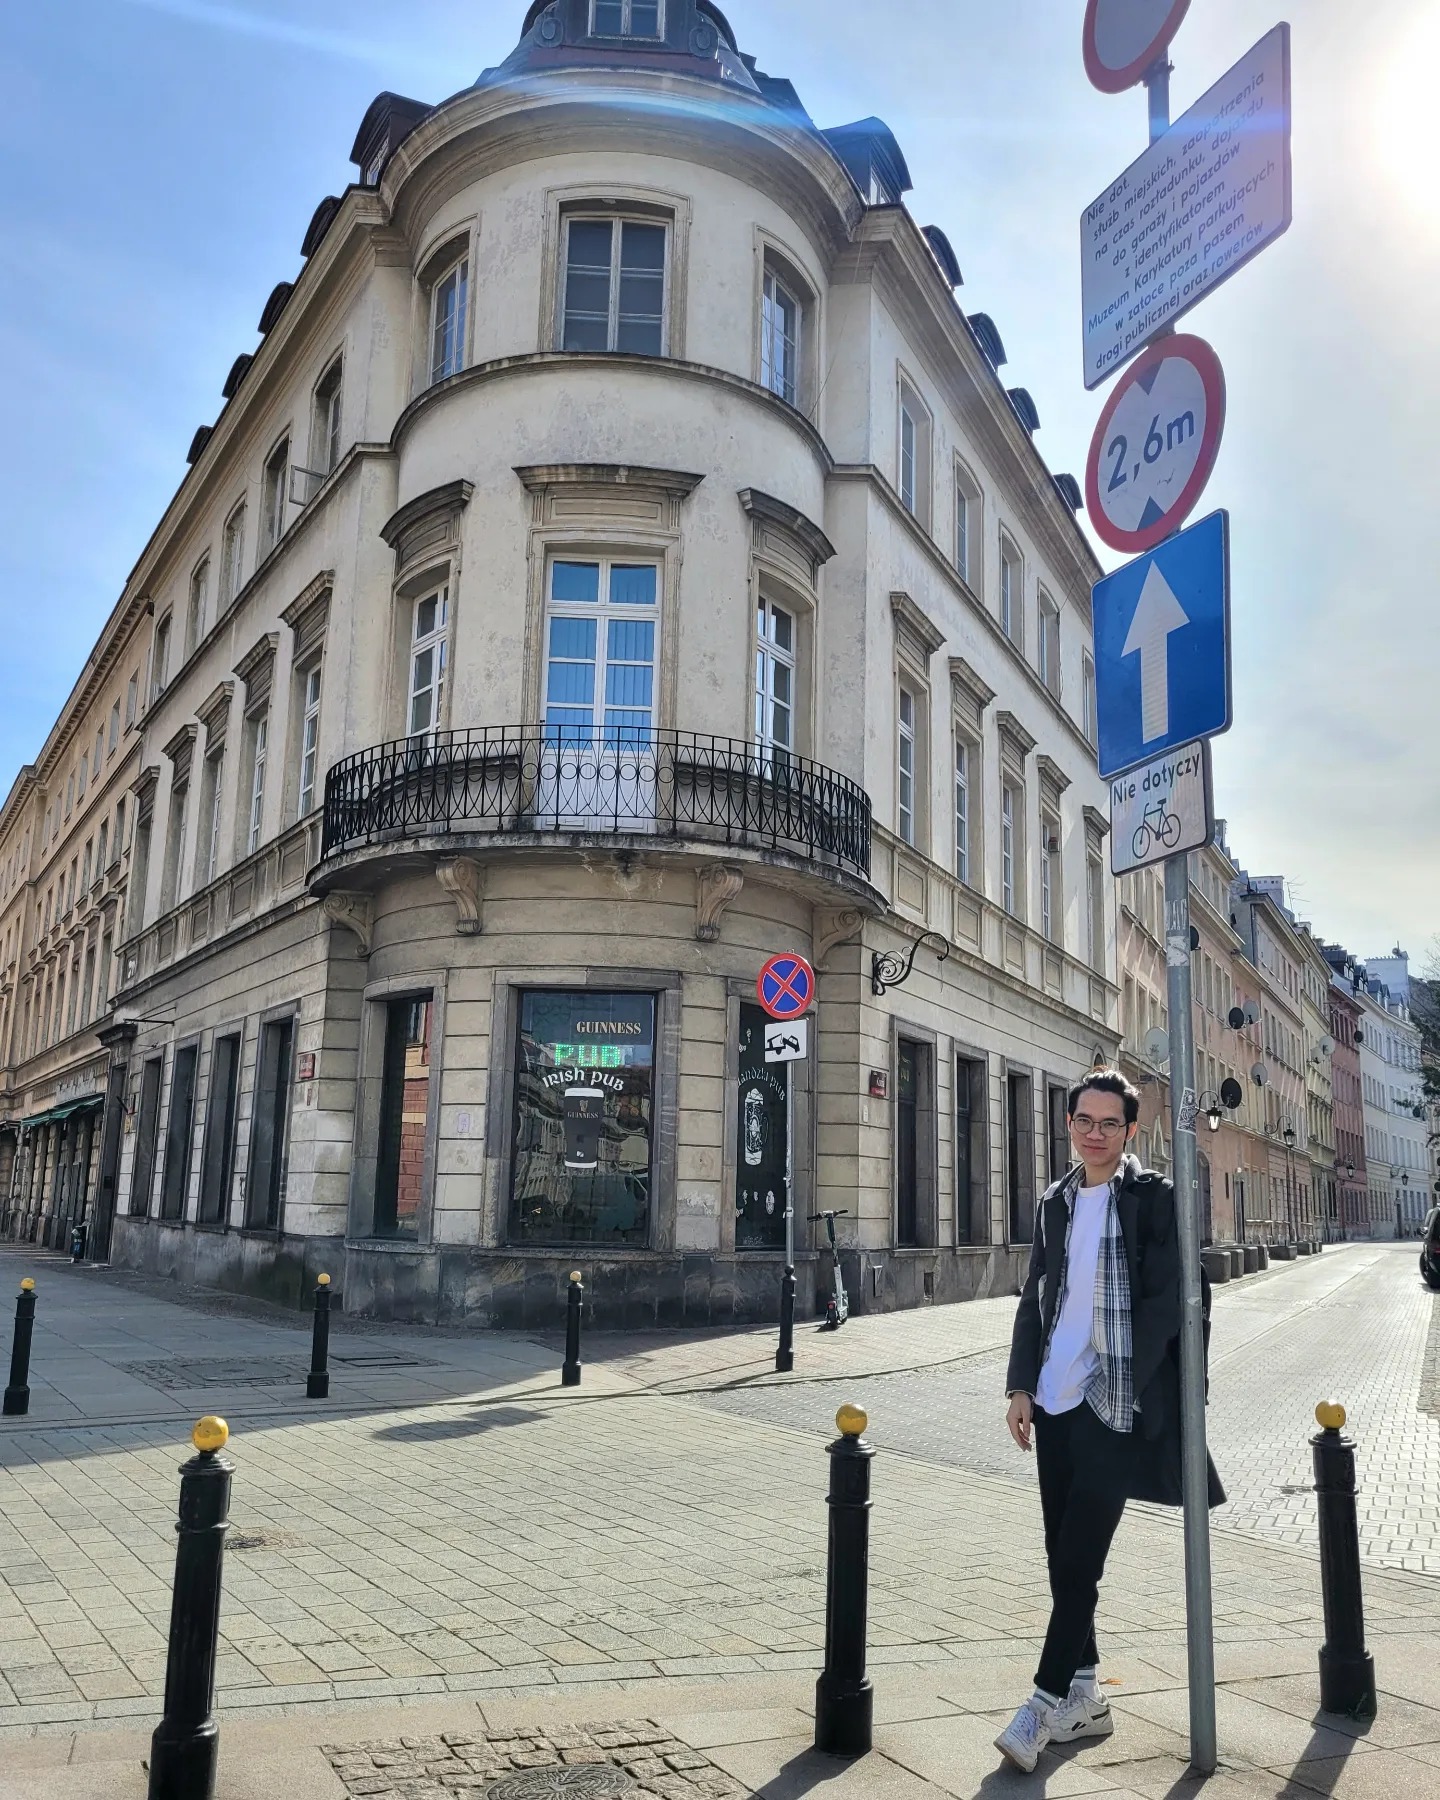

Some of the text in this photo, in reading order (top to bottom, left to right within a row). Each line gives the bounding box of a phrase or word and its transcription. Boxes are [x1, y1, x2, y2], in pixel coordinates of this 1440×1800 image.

[1087, 177, 1130, 225] Nie dot.
[1093, 72, 1264, 241] służb miejskich, zaopatrzenia
[1095, 97, 1263, 262] na czas rozładunku, dojazdu
[1112, 142, 1240, 267] do garaży i pojazdów
[1088, 160, 1275, 335] Muzeum Karykatury parkujących
[1115, 213, 1245, 332] w zatoce poza pasem
[1124, 181, 1225, 279] z identyfikatorem
[1096, 340, 1123, 370] drogi
[1125, 287, 1180, 348] publicznej
[1211, 220, 1264, 273] rowerów
[1107, 410, 1195, 494] 2,6m
[1113, 752, 1200, 807] Nie dotyczy
[554, 1044, 621, 1068] PUB
[576, 1021, 642, 1034] GUINNESS
[567, 1111, 599, 1119] GUINNESS
